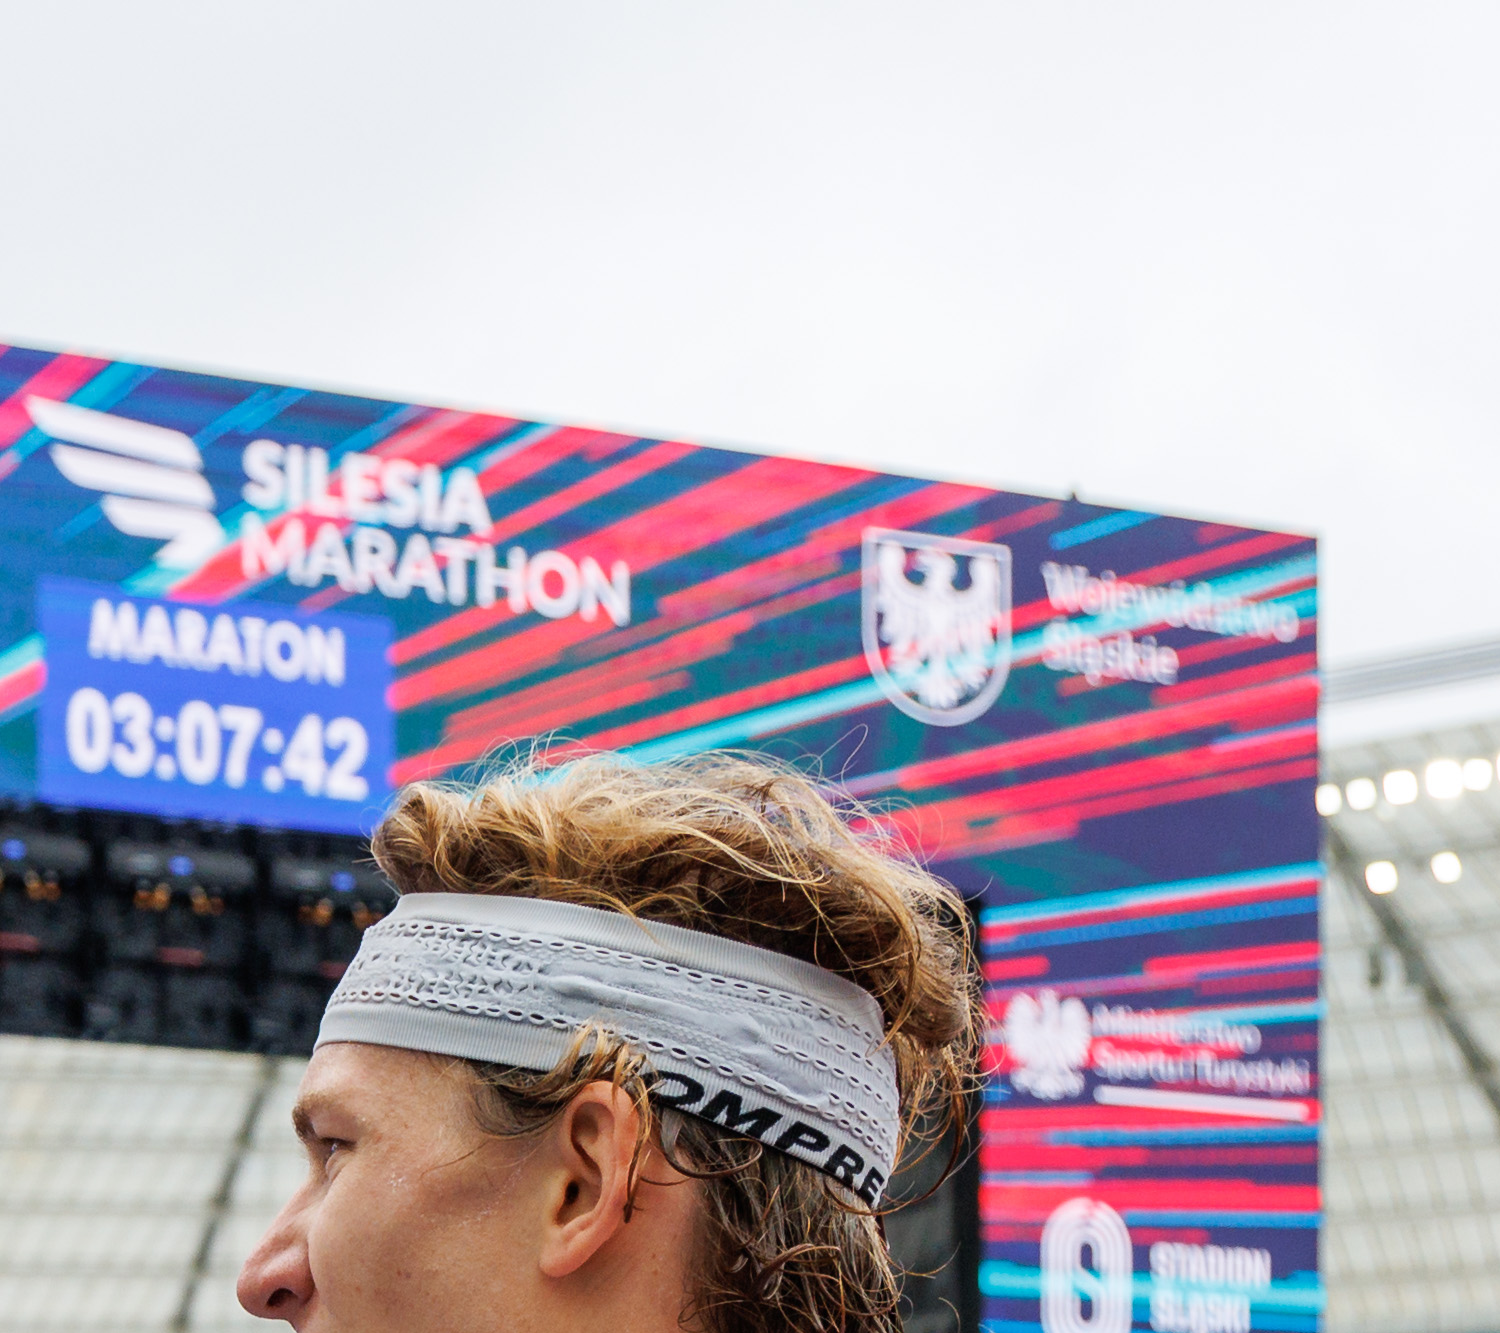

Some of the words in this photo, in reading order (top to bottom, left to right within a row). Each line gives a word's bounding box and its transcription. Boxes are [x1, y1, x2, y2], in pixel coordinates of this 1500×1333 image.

[242, 438, 494, 536] SILESIA
[240, 511, 631, 627] MARATHON
[89, 598, 346, 688] MARATON
[67, 687, 369, 801] 03:07:42
[640, 1069, 884, 1205] OMPRE
[1150, 1241, 1271, 1292] STADION
